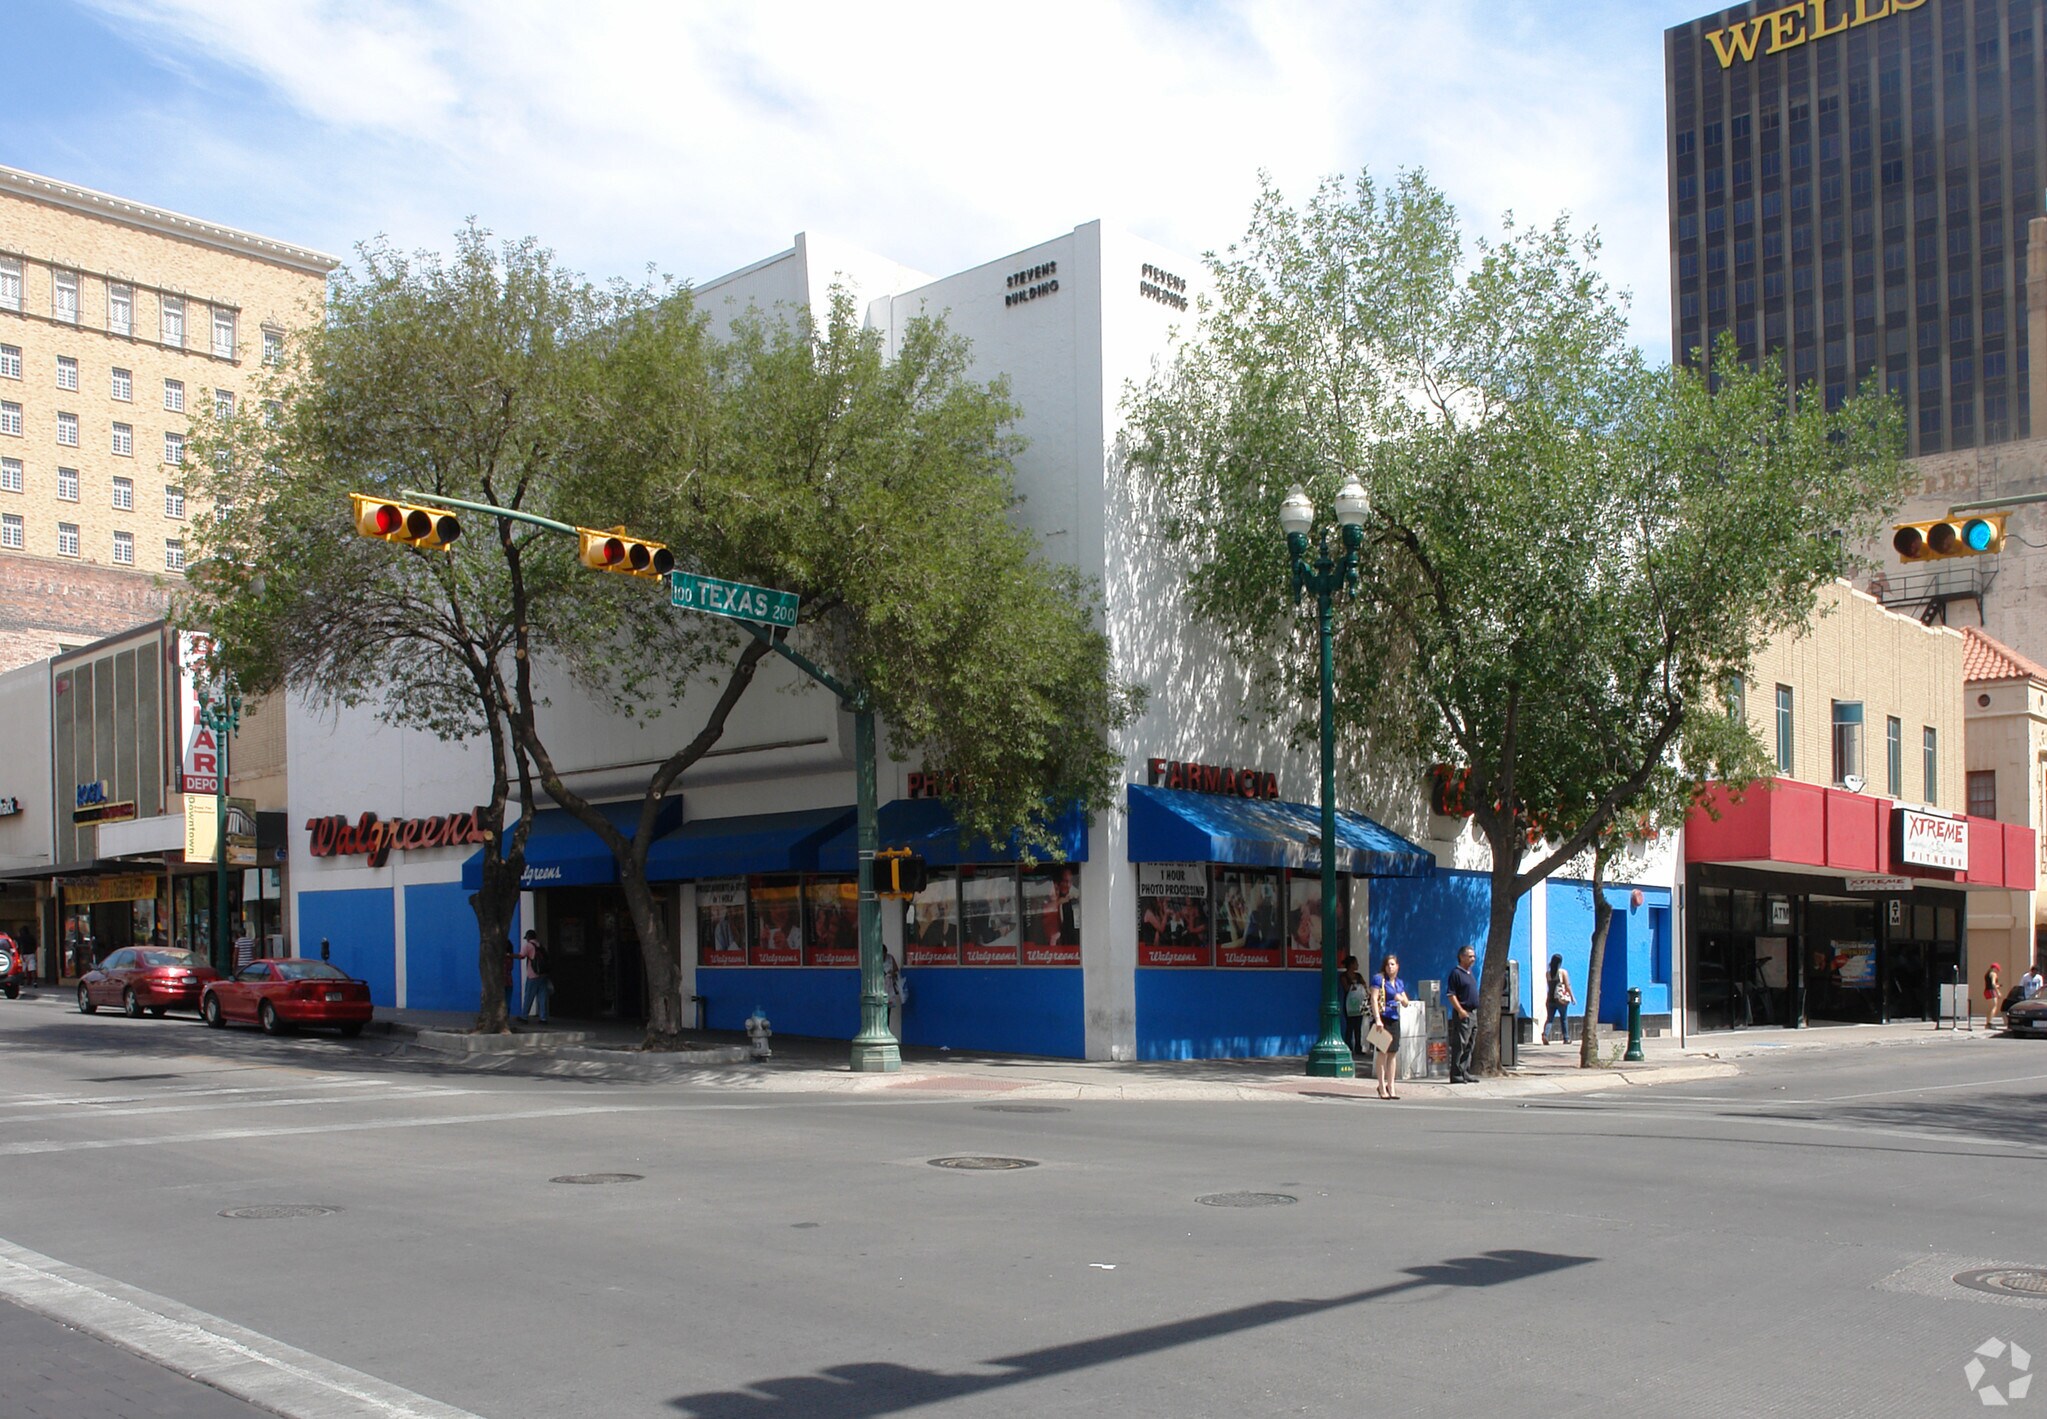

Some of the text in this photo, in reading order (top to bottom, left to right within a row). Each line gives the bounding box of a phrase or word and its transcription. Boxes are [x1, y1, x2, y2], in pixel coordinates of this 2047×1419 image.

[1705, 0, 1930, 69] WELL
[1006, 260, 1057, 288] STEVENS
[1141, 263, 1187, 293] STEVENS
[1005, 279, 1060, 307] BUILDING
[1140, 281, 1189, 313] BUILDING
[673, 581, 795, 622] 100 TEXAS 200
[187, 777, 218, 791] DEPO
[1147, 757, 1279, 798] FARMACIA
[188, 796, 196, 854] Downtown
[1908, 814, 1964, 843] XTREME
[305, 806, 487, 868] Walgreens
[520, 864, 562, 886] lgreens
[1160, 869, 1185, 881] 1 HOUR
[1141, 883, 1205, 897] PHOTO PROCESSING
[1773, 906, 1789, 920] ATM
[1891, 901, 1899, 924] ATM
[711, 953, 745, 965] Walgreens
[759, 953, 798, 965] Walgreens
[815, 953, 857, 965] Walgreens
[911, 951, 958, 964] Walgreens
[967, 951, 1016, 964] Walgreens
[1027, 950, 1080, 964] Walgreens
[1149, 951, 1197, 965] Walgreens
[1225, 952, 1270, 966] Walgreens
[1295, 953, 1323, 966] Walgr
